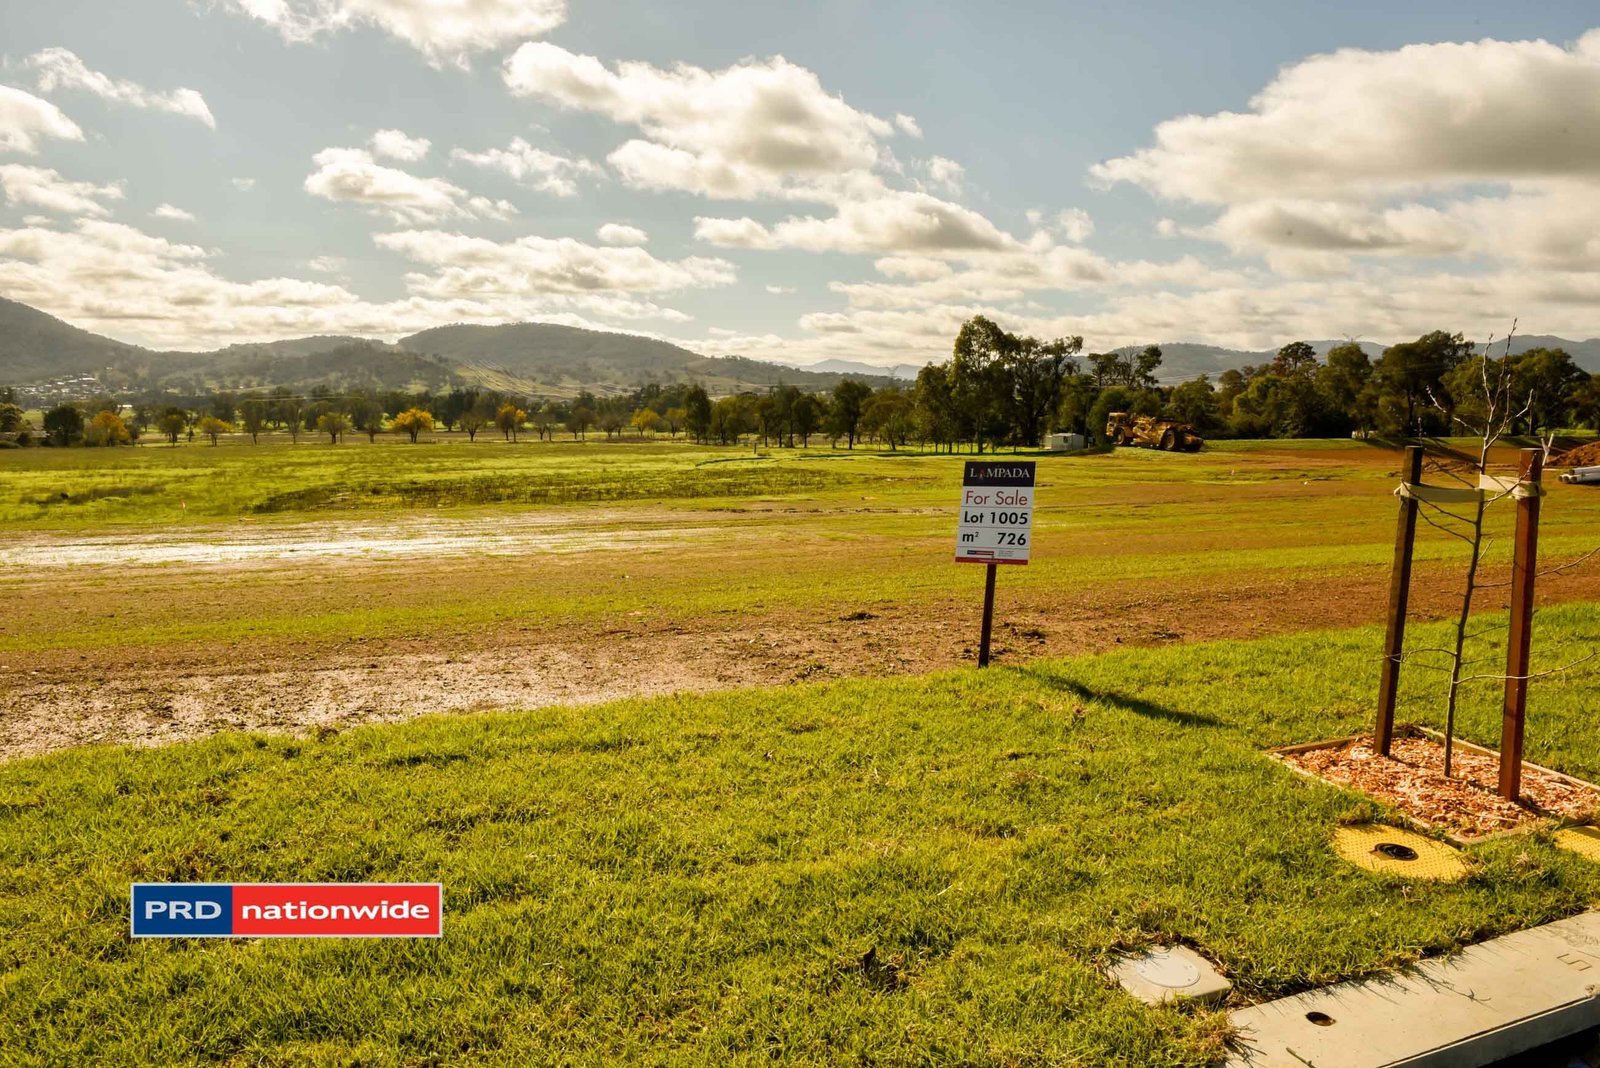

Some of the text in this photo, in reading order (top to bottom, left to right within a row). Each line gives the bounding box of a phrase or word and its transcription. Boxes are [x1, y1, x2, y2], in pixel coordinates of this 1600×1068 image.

[966, 489, 1028, 505] For Sale
[964, 511, 1028, 524] Lot 1005
[997, 532, 1026, 545] 726
